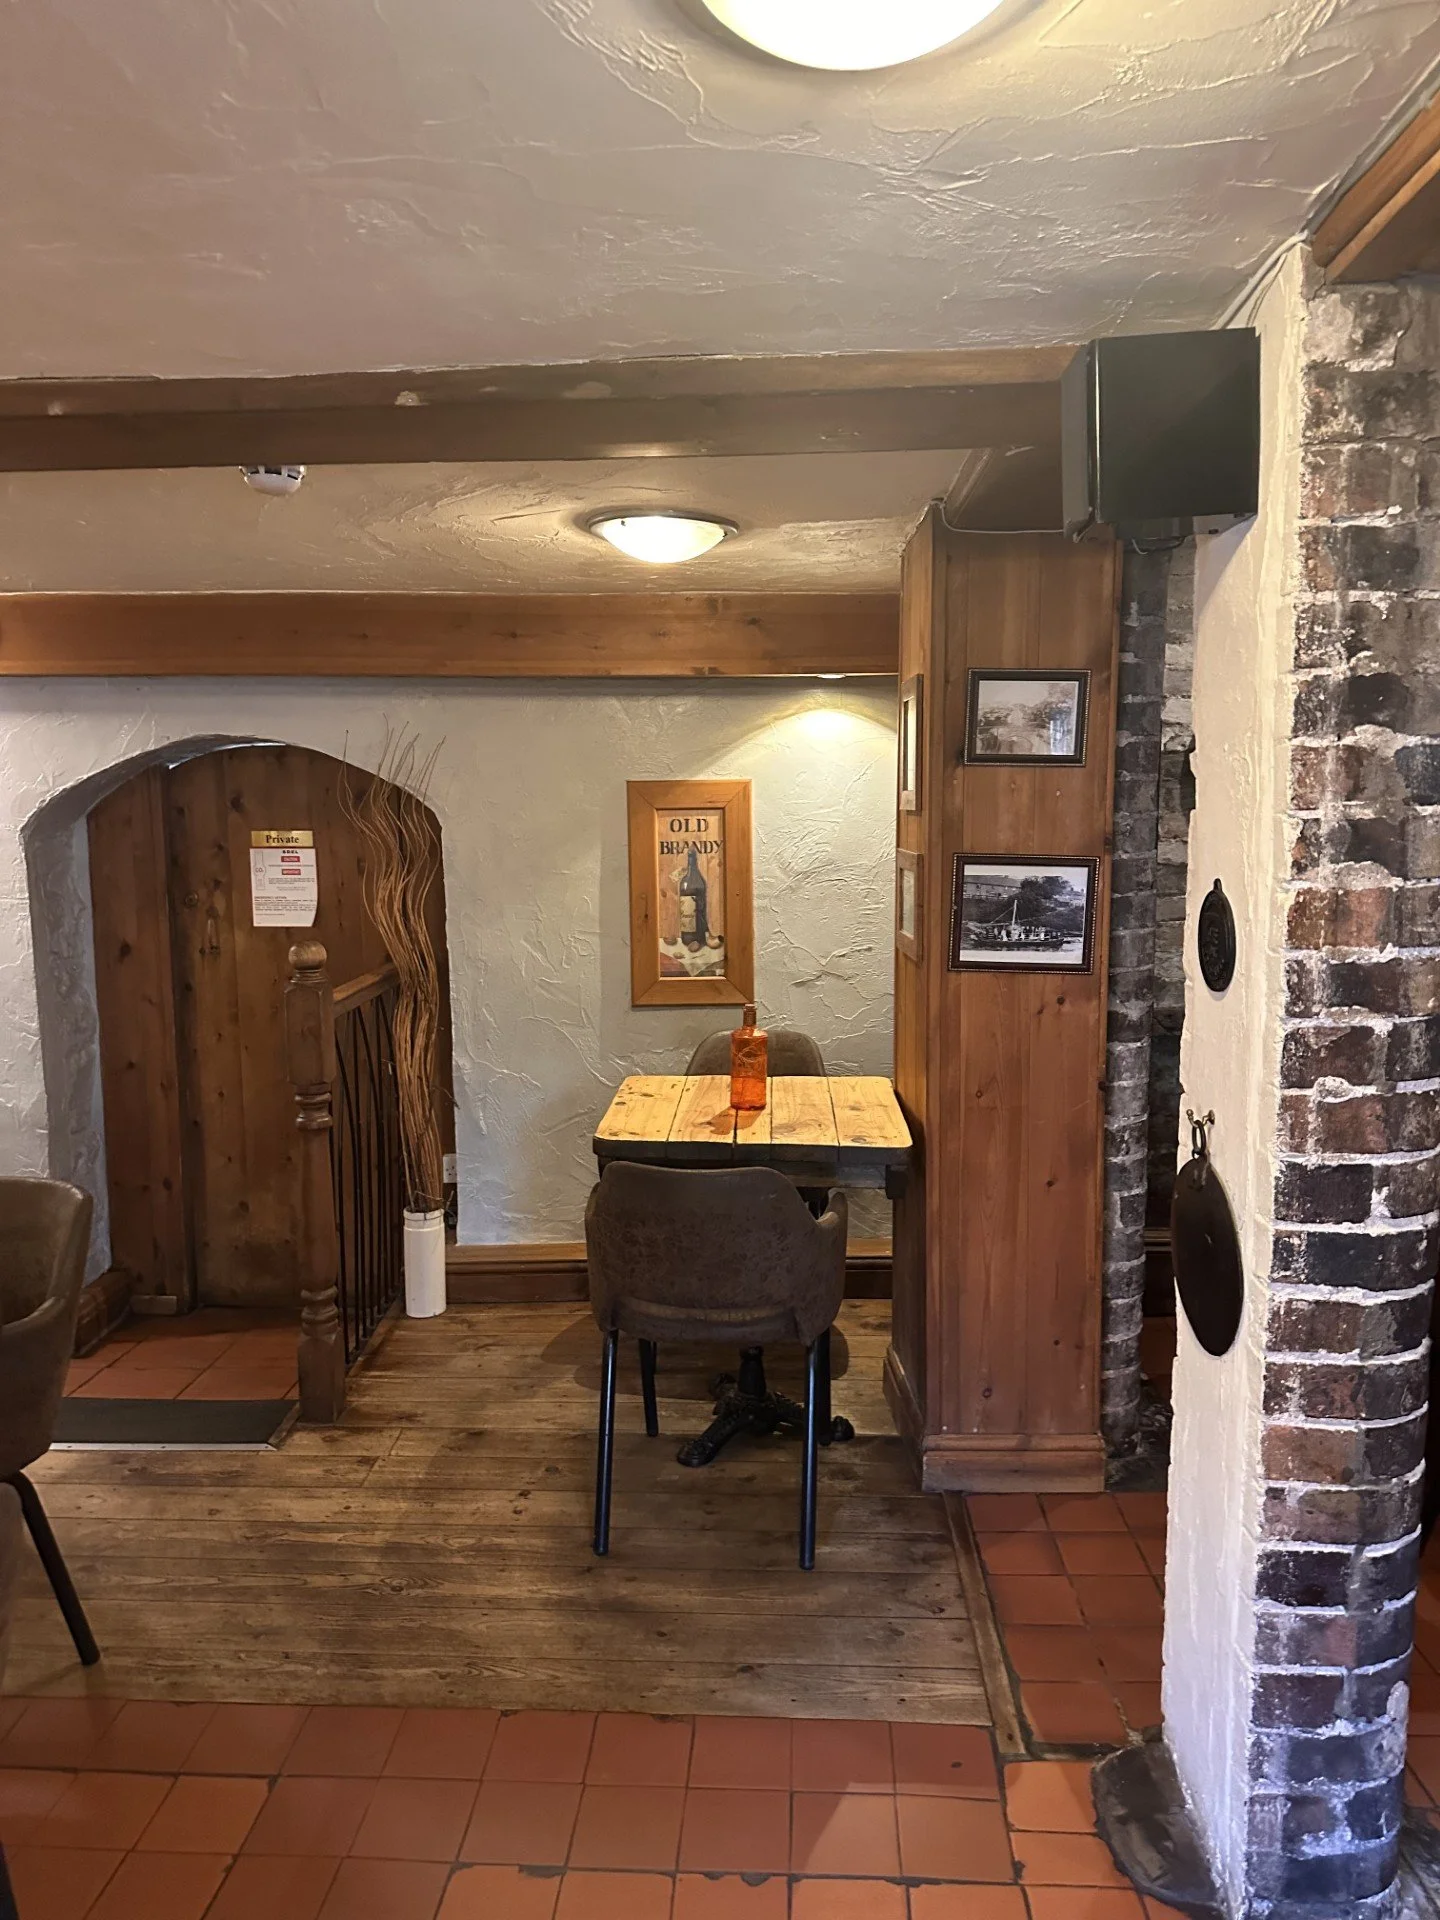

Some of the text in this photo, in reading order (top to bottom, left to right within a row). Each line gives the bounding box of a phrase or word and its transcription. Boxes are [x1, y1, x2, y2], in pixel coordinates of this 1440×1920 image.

[670, 818, 709, 833] OLD
[265, 834, 300, 844] Private
[660, 840, 724, 855] BRANDY
